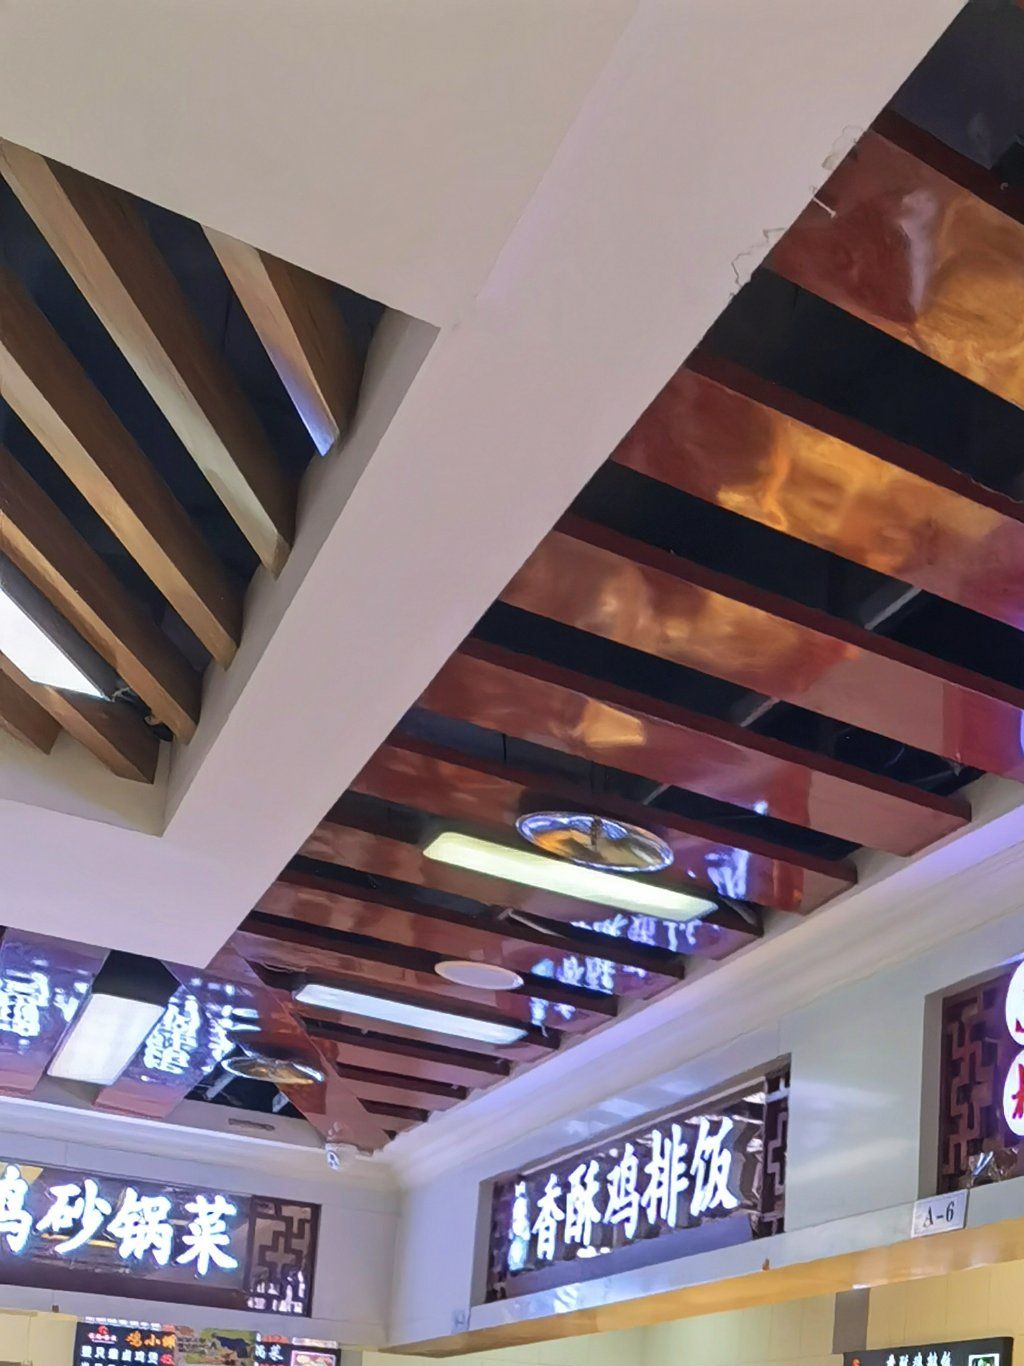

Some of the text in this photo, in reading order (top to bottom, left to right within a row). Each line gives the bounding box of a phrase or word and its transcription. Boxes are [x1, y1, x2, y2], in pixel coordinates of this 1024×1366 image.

[532, 1116, 738, 1261] 香酥鸡排饭
[922, 1200, 956, 1229] A-6
